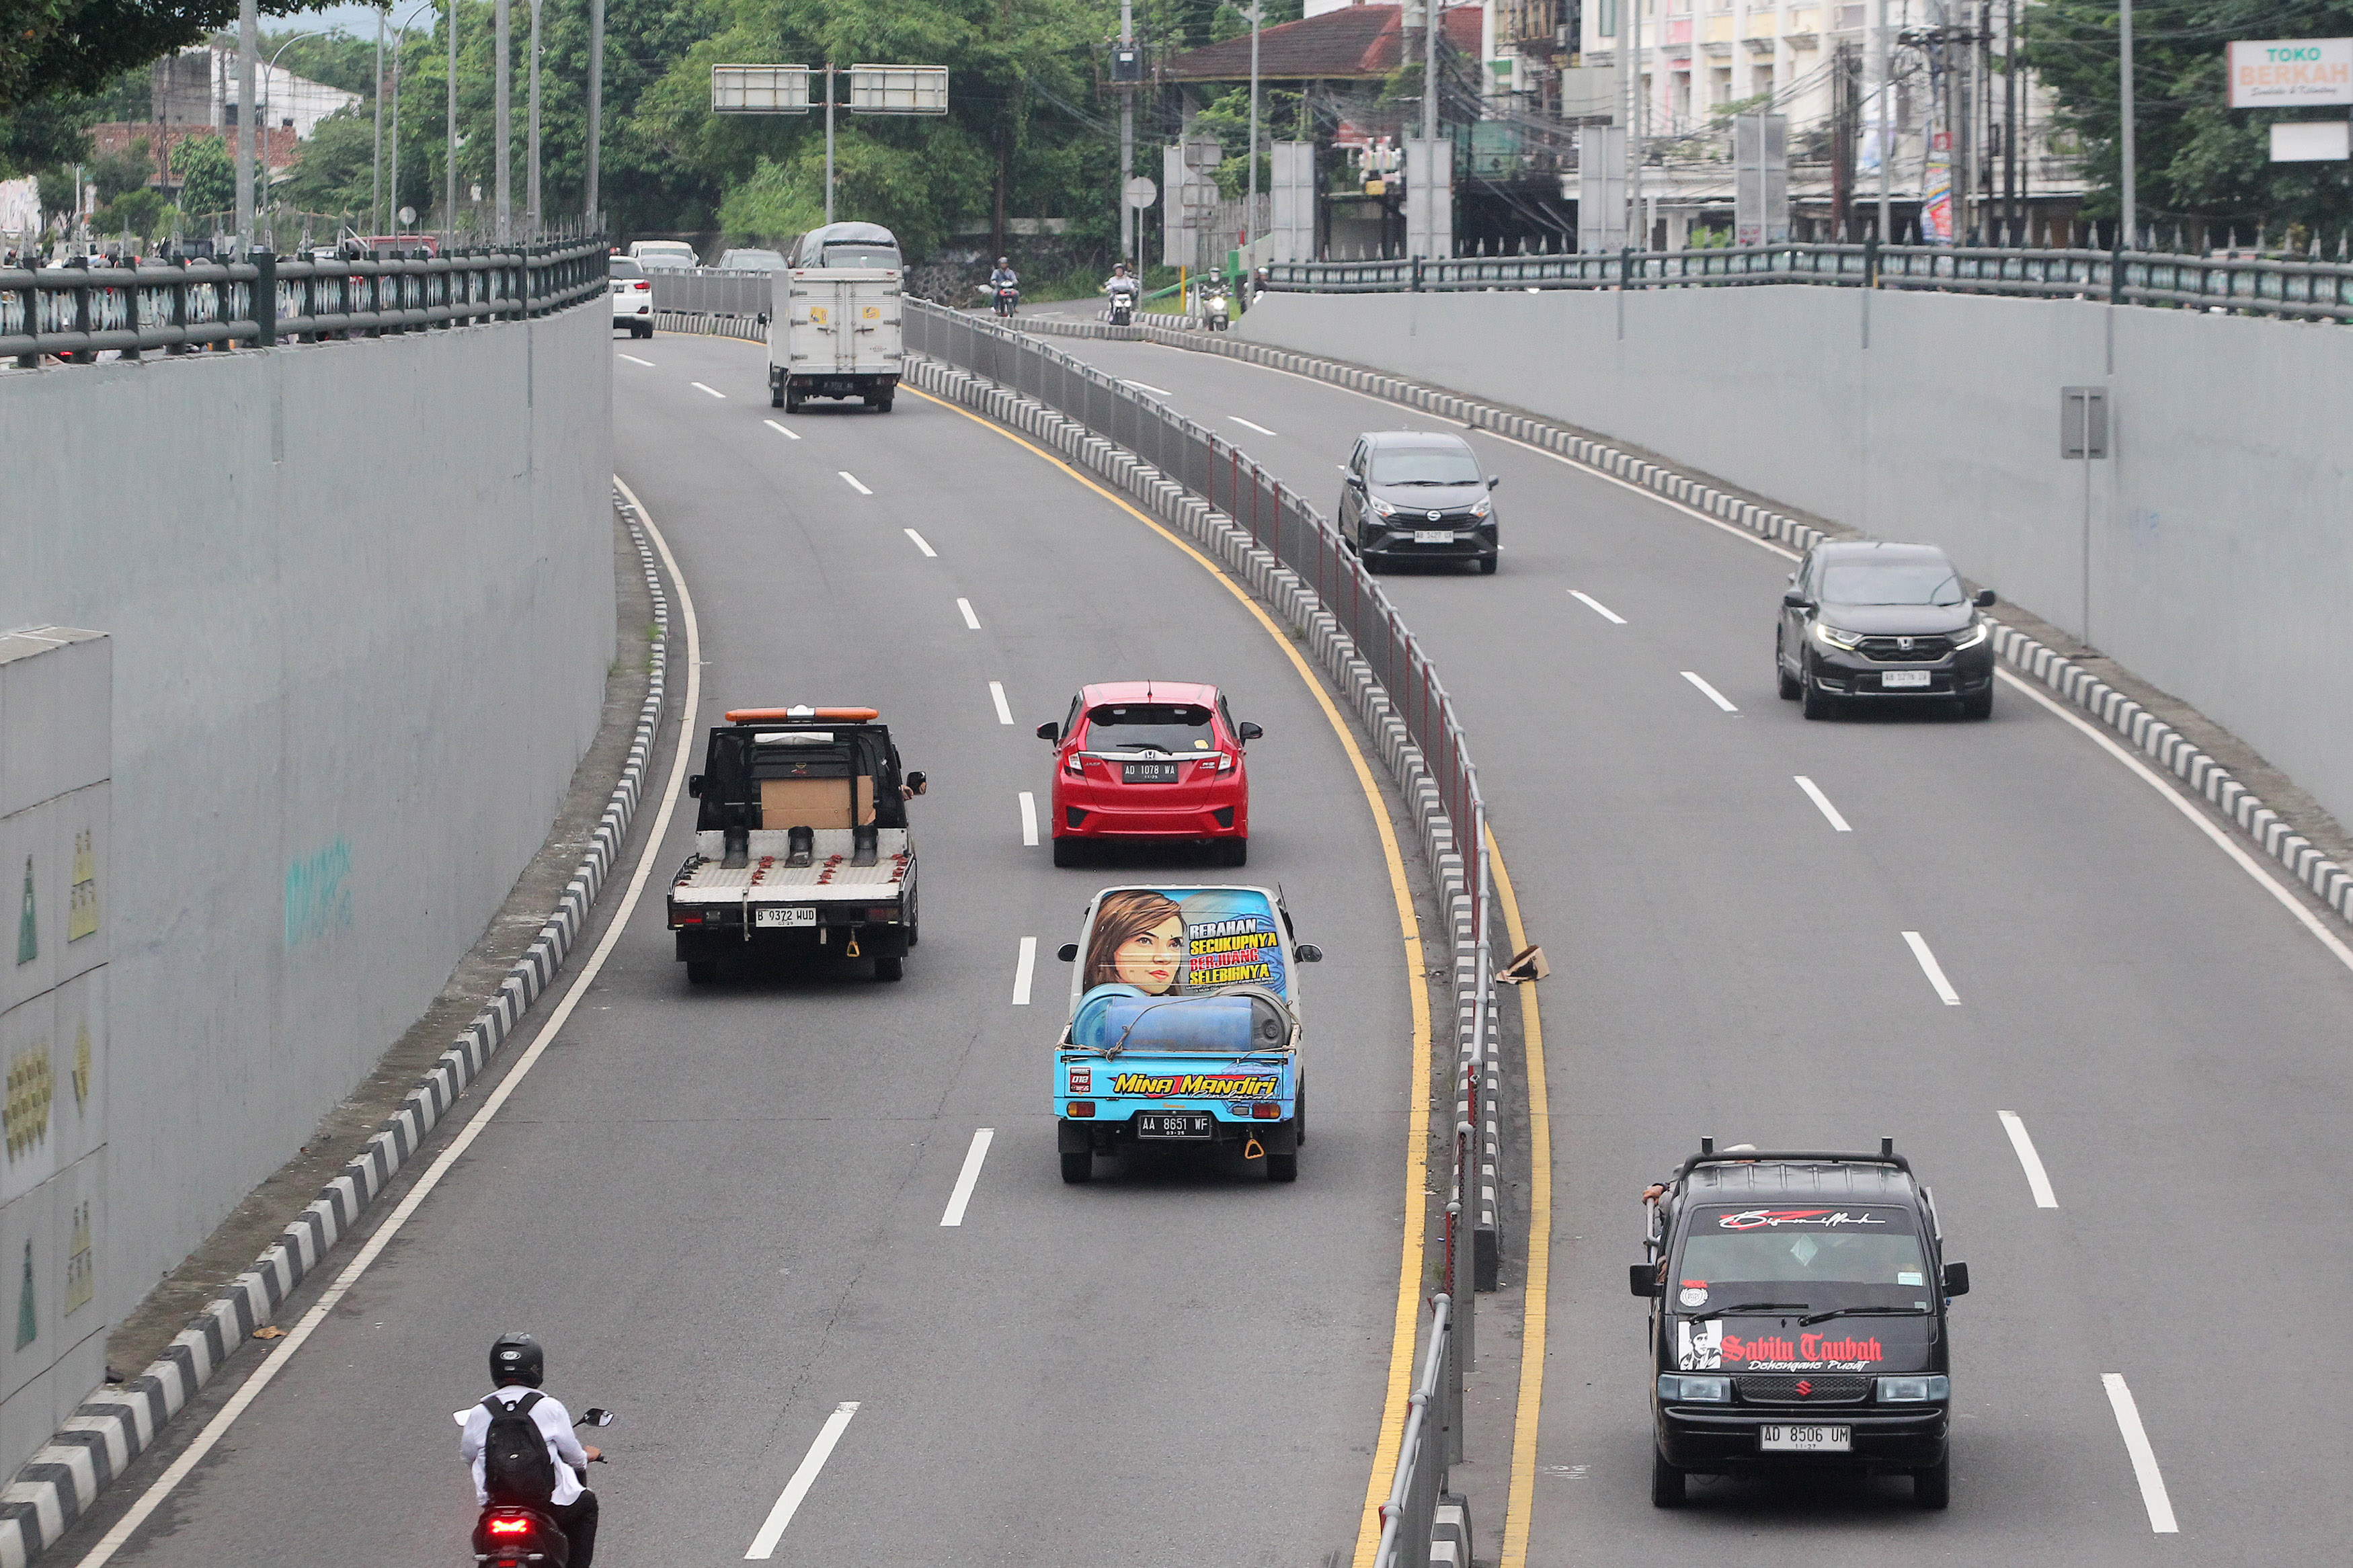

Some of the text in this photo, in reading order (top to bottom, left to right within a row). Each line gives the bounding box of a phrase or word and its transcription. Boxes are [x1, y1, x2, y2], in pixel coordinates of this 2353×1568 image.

[2266, 47, 2321, 62] TOKO
[2240, 64, 2348, 85] BERKAH
[1125, 766, 1175, 774] AD 1078 WA
[758, 911, 764, 921] B
[769, 910, 792, 921] 9372
[1189, 918, 1257, 940] REBAHAN
[1190, 932, 1278, 955] SECUKUPNYA
[1189, 948, 1259, 971] BERJUANG
[1189, 963, 1271, 984] SELEBIHNYA
[1072, 1075, 1089, 1083] 012
[1143, 1118, 1208, 1130] AA 8651 WF
[1718, 1210, 1886, 1227] Bismillah
[1720, 1332, 1884, 1363] Sabilu Taubah
[1765, 1426, 1848, 1442] AD 8506 UM
